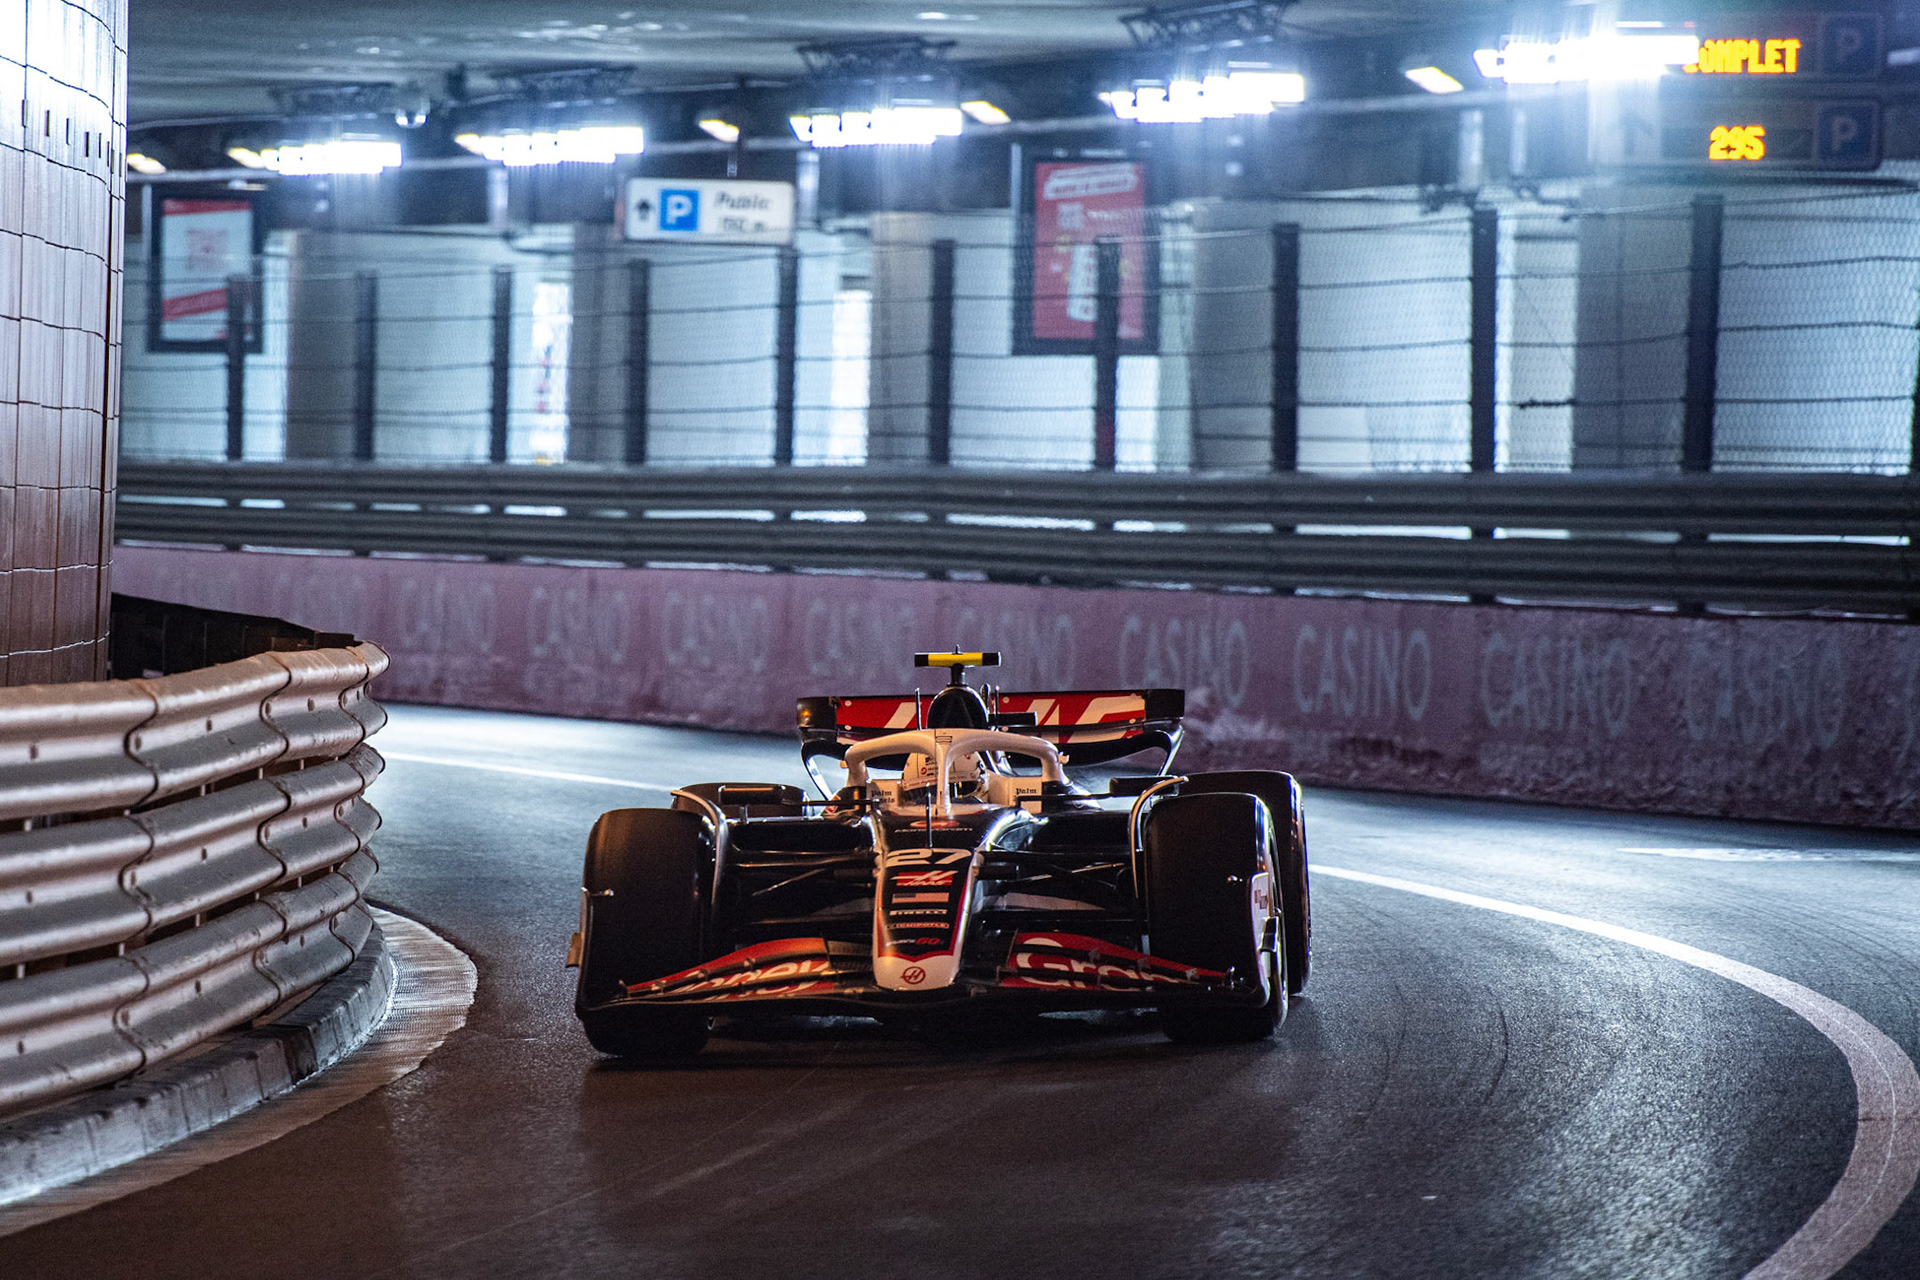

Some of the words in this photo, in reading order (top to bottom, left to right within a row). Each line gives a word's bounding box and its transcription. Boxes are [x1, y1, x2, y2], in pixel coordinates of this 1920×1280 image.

[1682, 37, 1802, 74] OMPLET
[1708, 124, 1765, 161] 295
[666, 194, 693, 225] P
[1119, 614, 1249, 707] CASINO
[1293, 622, 1432, 721] CASINO
[1481, 630, 1632, 737] CASINO
[1016, 788, 1037, 796] Palm
[886, 848, 972, 868] 27
